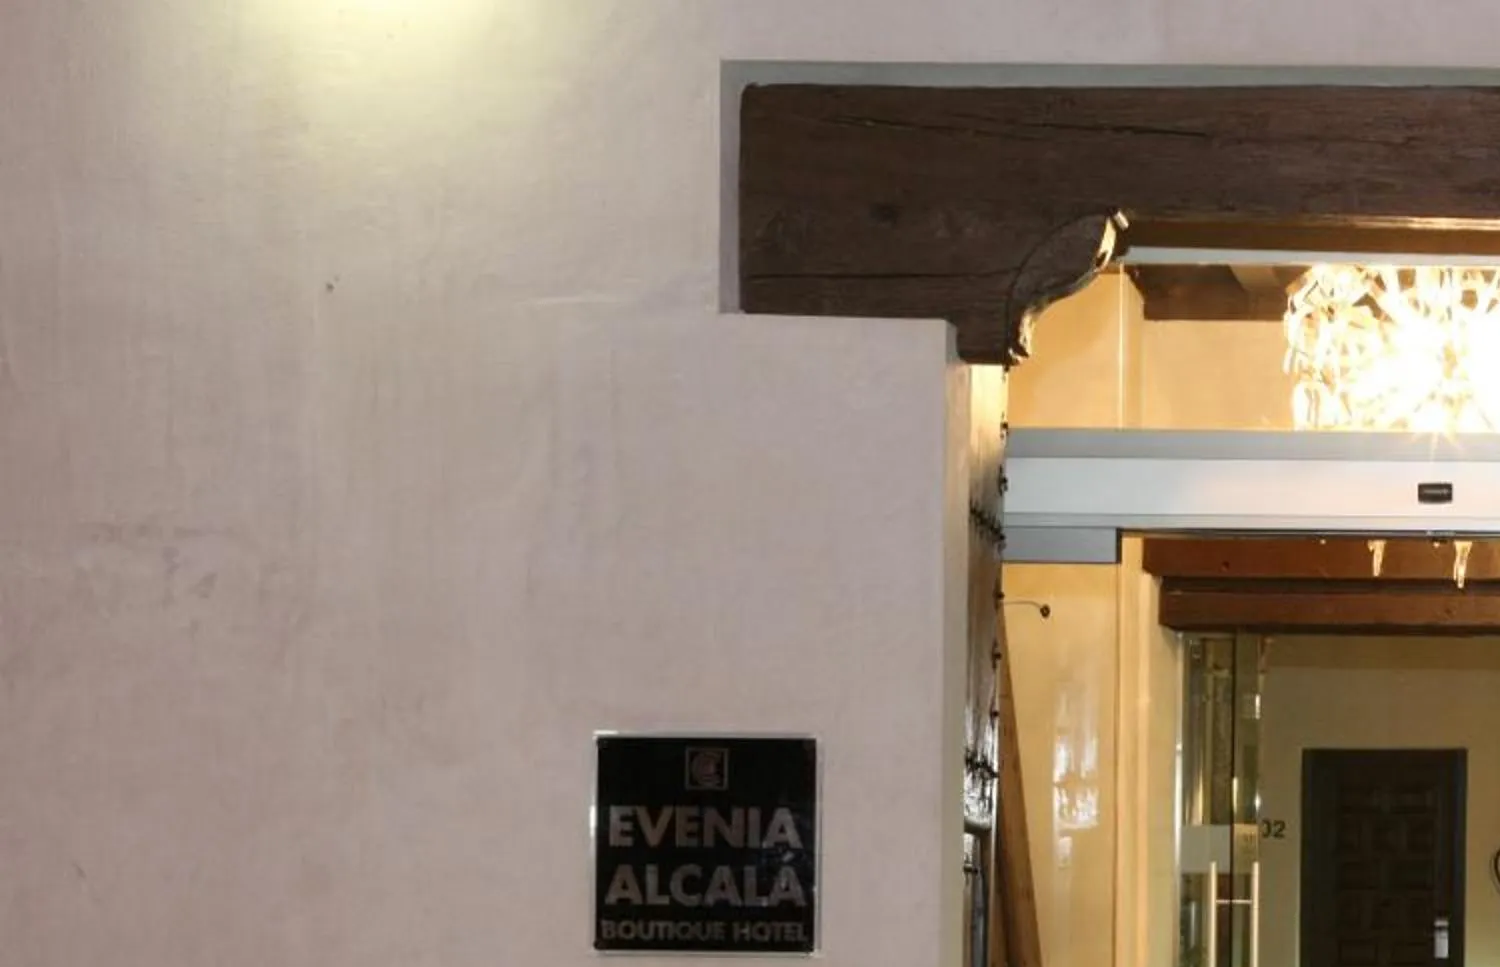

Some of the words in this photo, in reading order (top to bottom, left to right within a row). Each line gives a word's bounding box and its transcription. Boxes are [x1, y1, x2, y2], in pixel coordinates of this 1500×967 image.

[609, 805, 803, 849] EVENIA
[604, 850, 808, 907] ALCALÁ
[601, 919, 727, 942] BOUTIQUE
[733, 920, 808, 943] HOTEL
